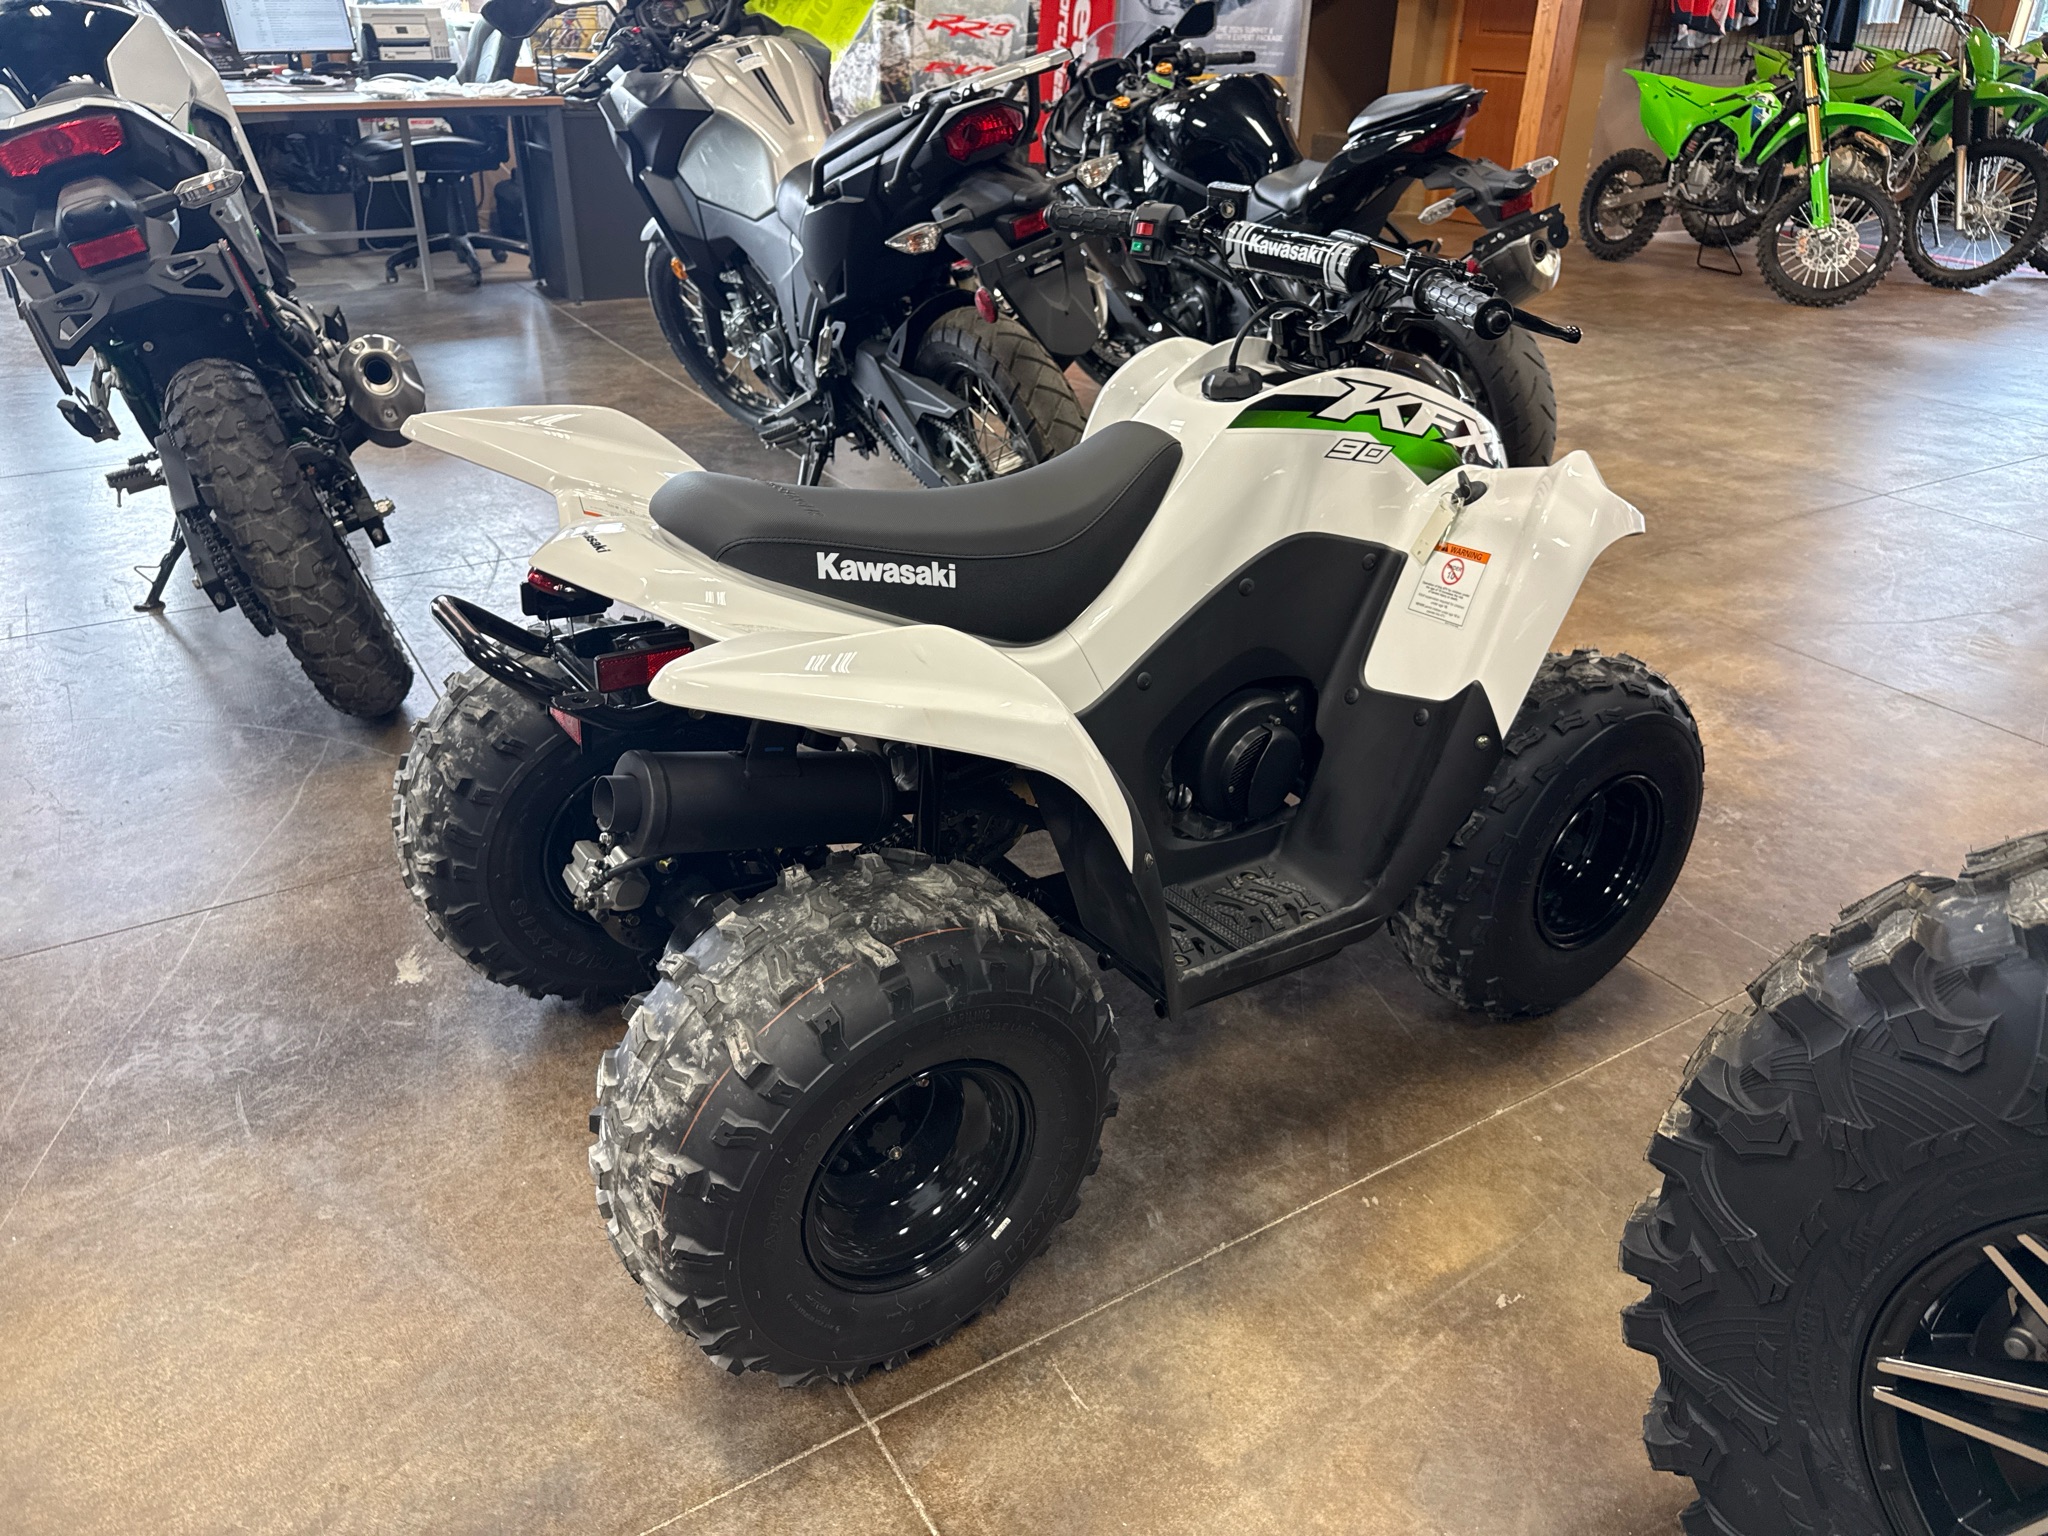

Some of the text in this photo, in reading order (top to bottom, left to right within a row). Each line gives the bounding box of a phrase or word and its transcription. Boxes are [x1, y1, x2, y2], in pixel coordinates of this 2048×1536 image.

[1248, 233, 1324, 264] Kawasaki
[1307, 377, 1494, 466] KFX
[1324, 438, 1396, 464] 90
[1450, 545, 1483, 561] WARNING
[816, 551, 956, 588] Kawasaki
